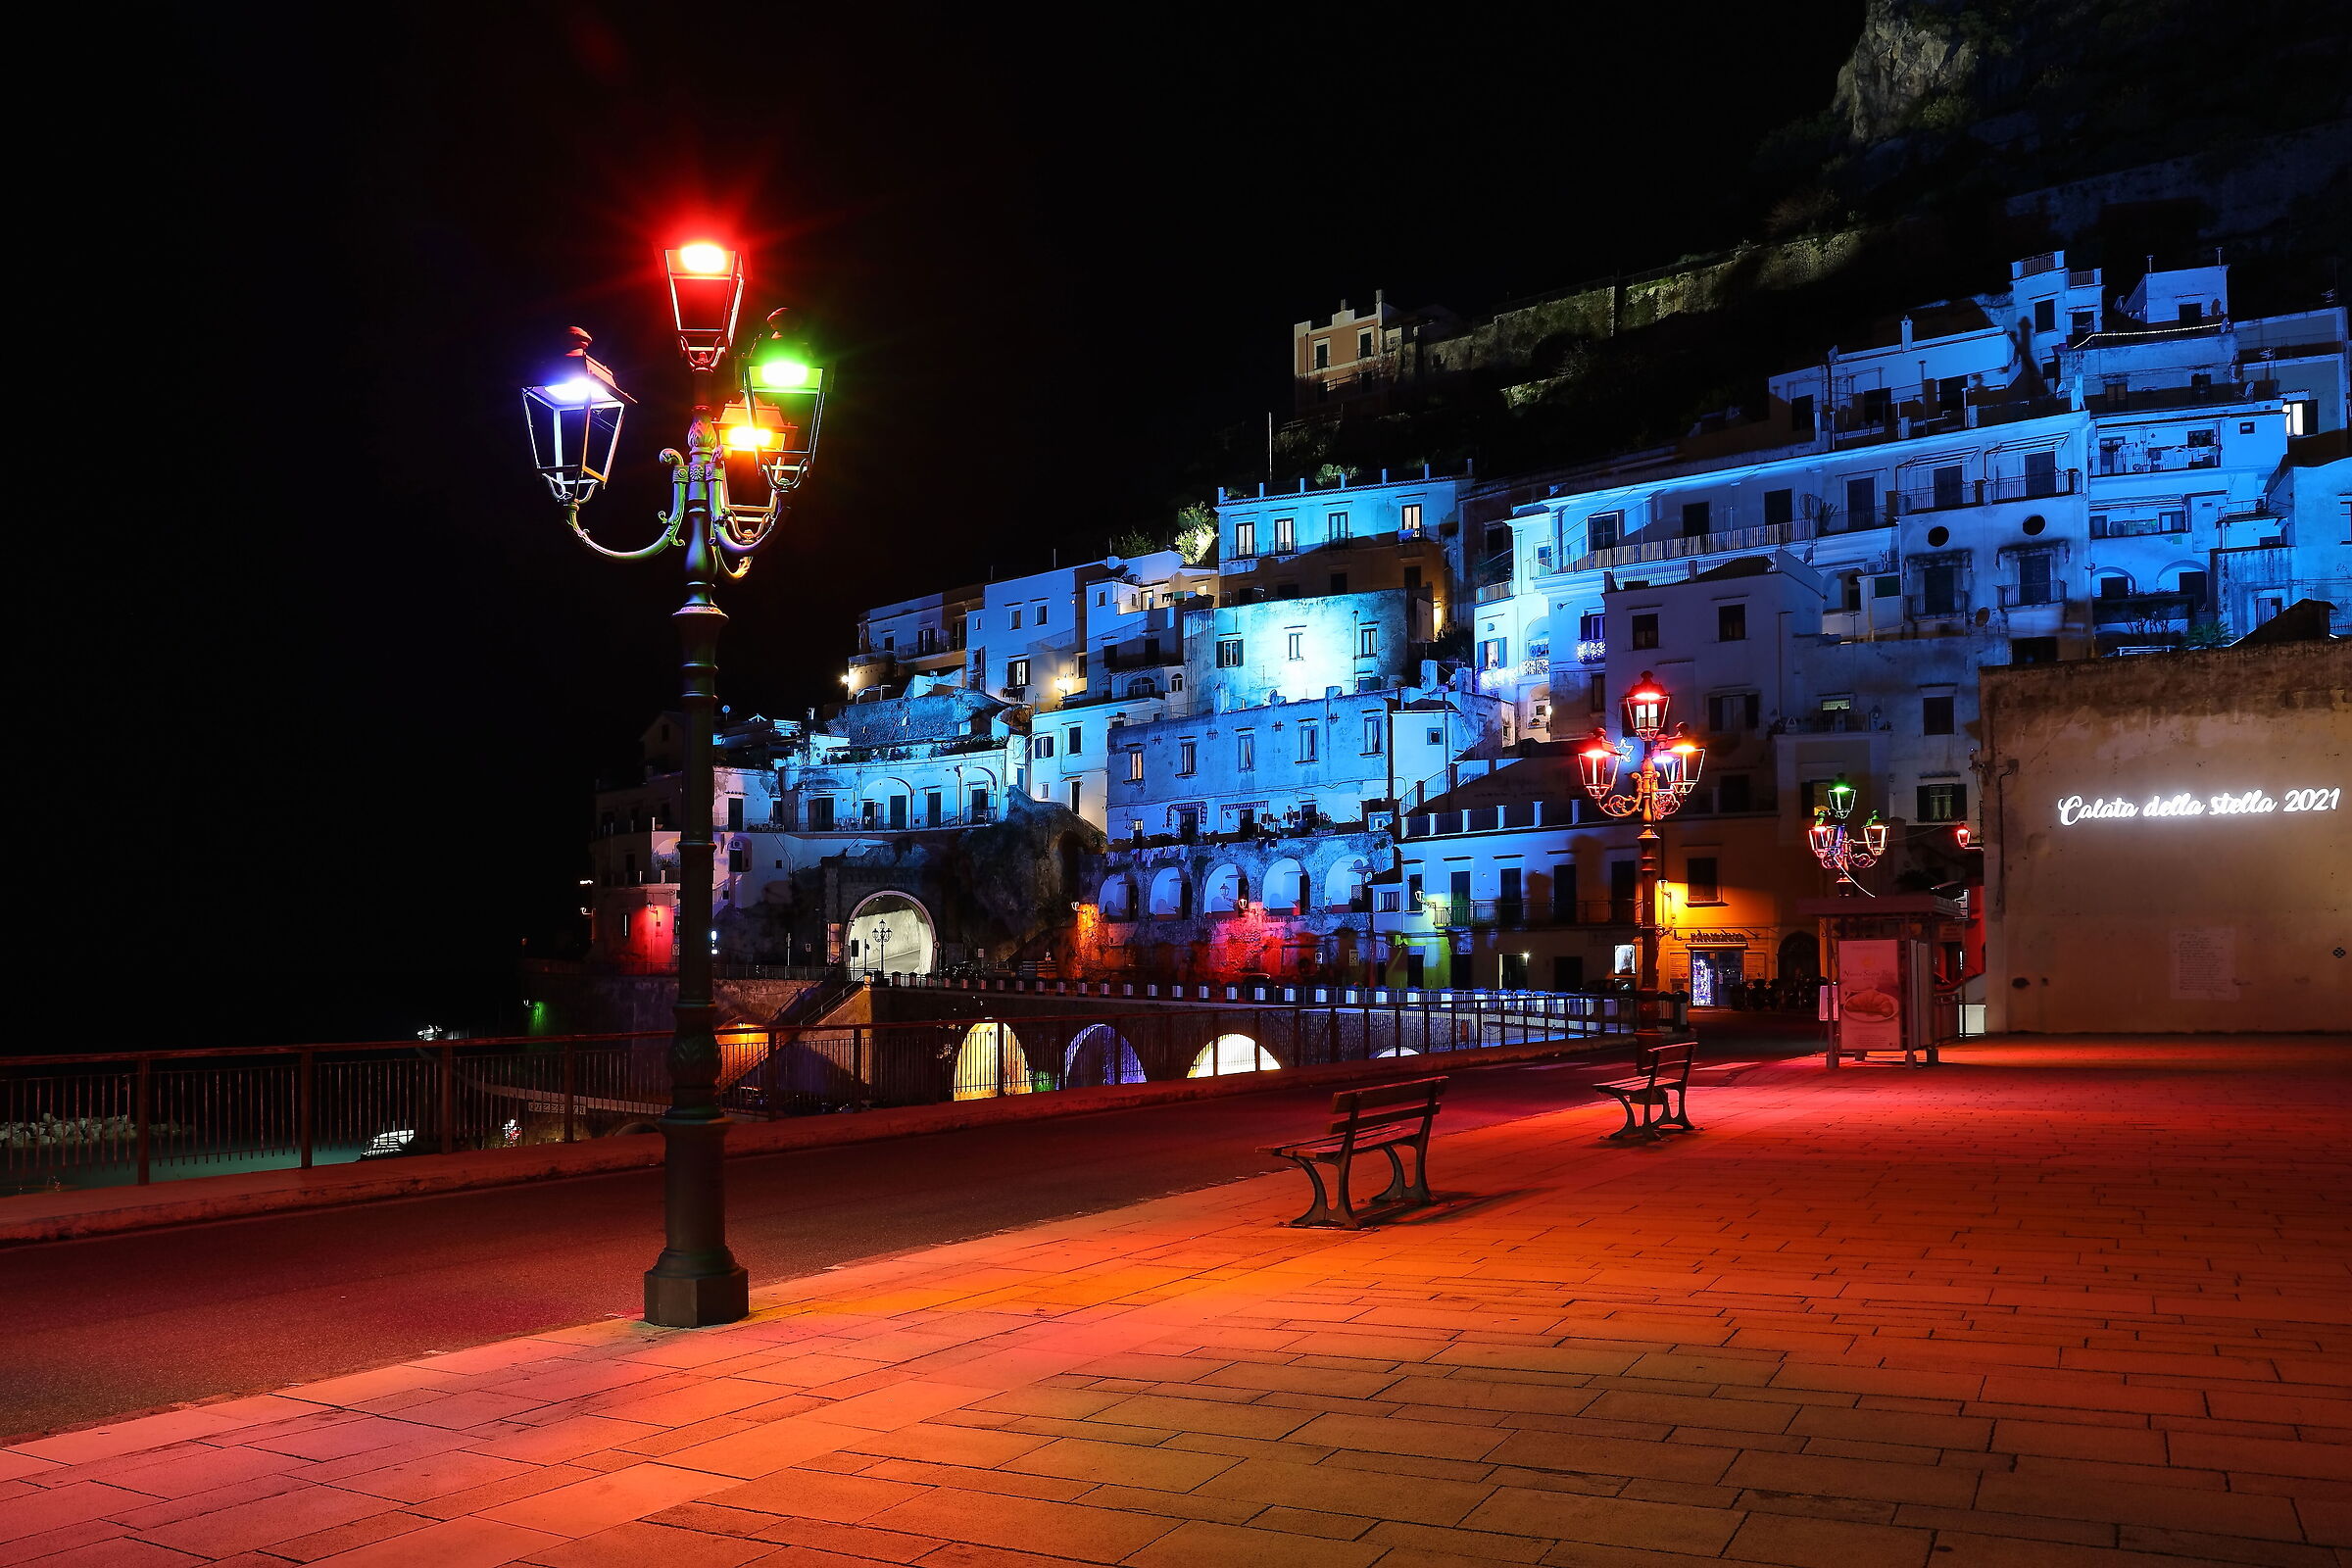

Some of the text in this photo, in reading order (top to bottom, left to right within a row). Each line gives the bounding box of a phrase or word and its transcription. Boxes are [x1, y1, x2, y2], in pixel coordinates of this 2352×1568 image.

[2057, 788, 2341, 825] Calata della stella 2021
